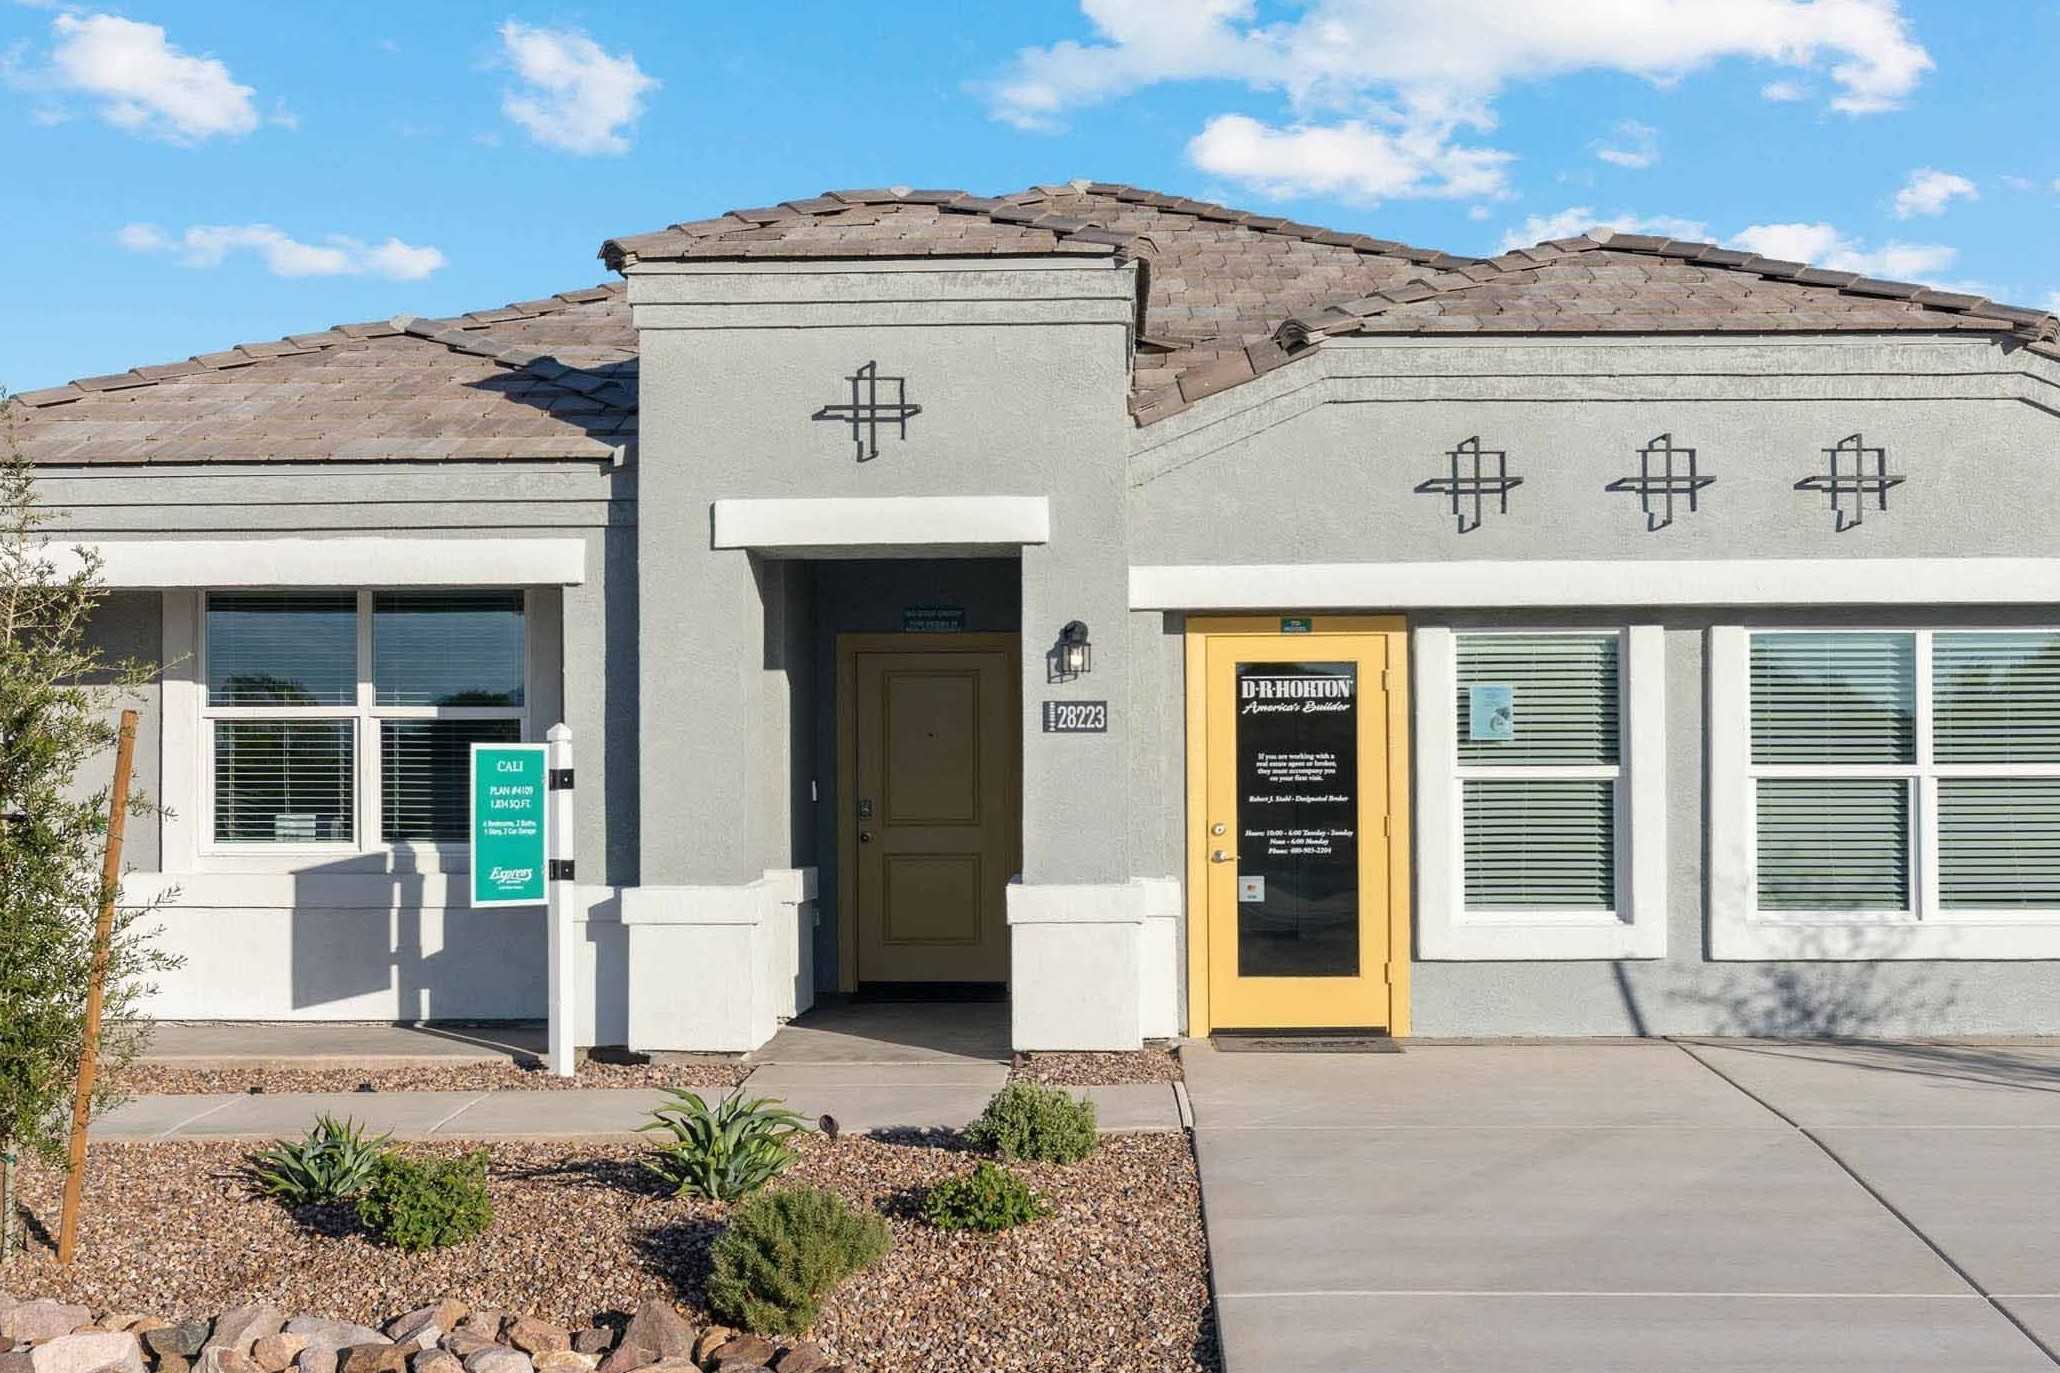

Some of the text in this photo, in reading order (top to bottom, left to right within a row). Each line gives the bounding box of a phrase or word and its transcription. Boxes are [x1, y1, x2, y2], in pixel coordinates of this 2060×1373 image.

[1241, 701, 1350, 714] America's Builder
[1057, 705, 1104, 728] 28223
[1258, 752, 1265, 760] If
[1265, 754, 1277, 762] you
[1288, 752, 1314, 761] working
[497, 760, 524, 772] CALI
[1257, 768, 1271, 776] they
[1279, 775, 1294, 783] your
[490, 786, 510, 796] PLAN
[1295, 795, 1329, 803] Designated
[1305, 838, 1329, 846] Monday
[488, 866, 533, 883] Express
